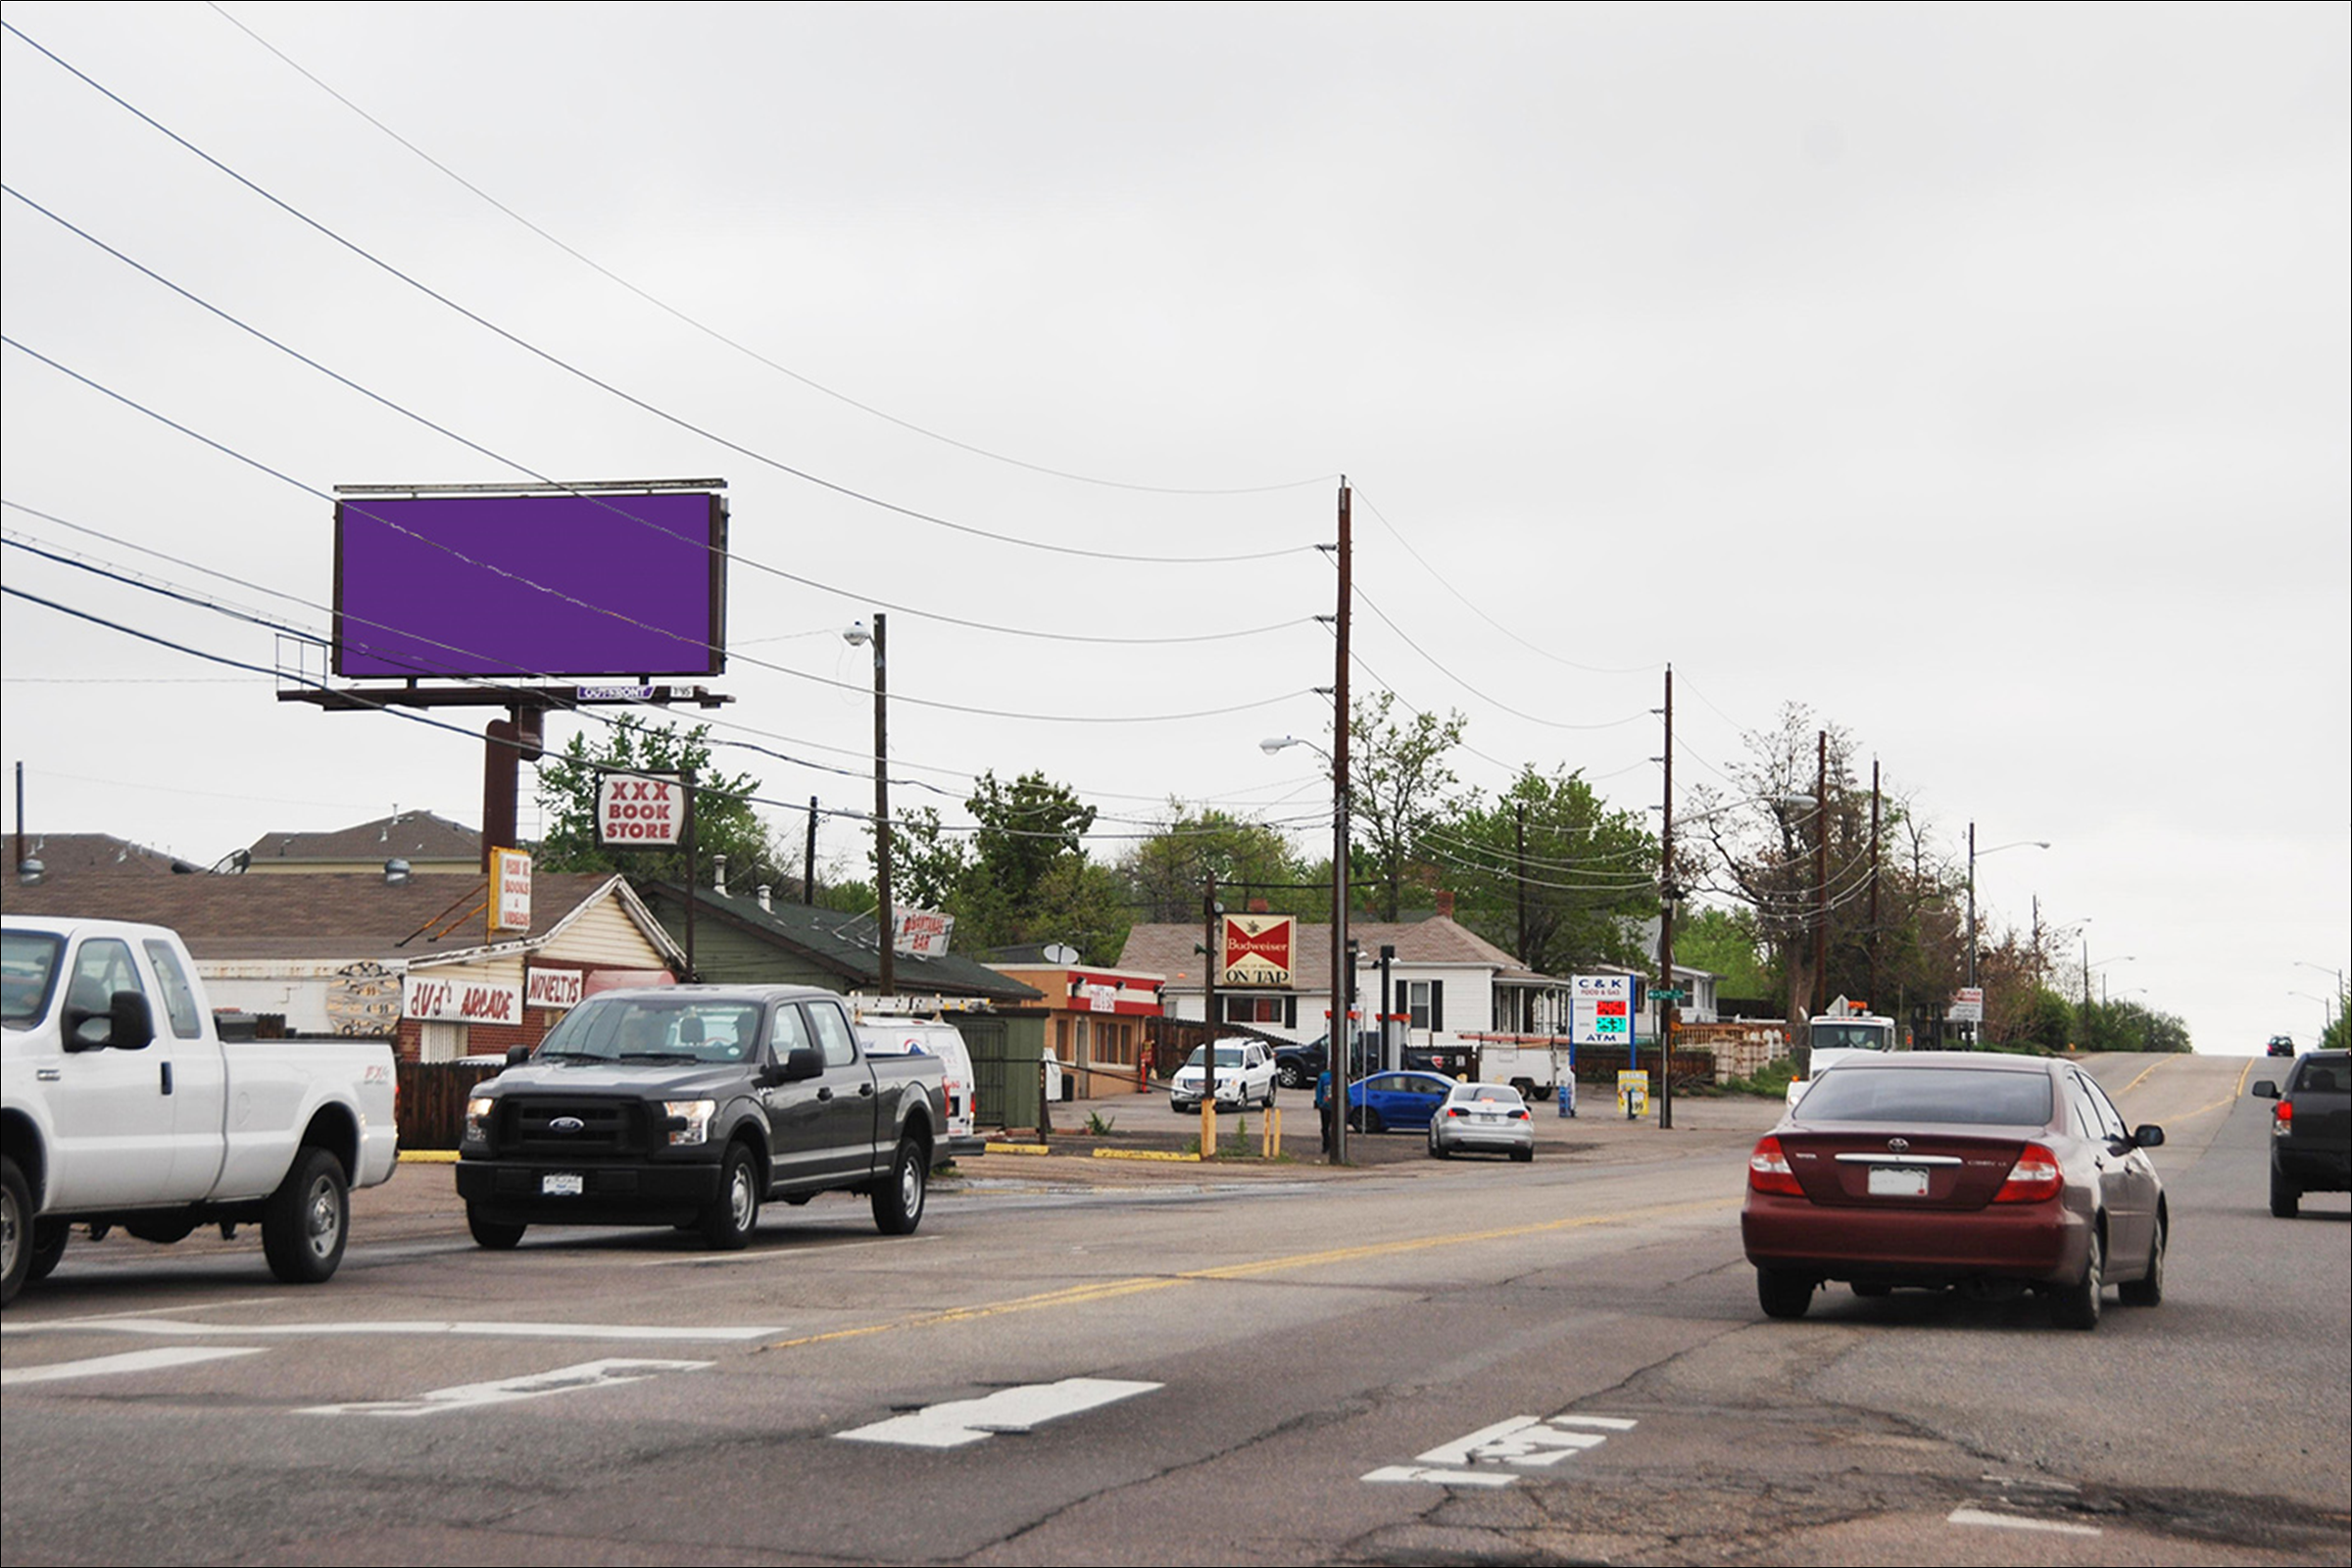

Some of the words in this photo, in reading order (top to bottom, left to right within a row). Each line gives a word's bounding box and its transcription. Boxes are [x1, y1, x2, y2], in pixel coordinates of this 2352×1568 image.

[610, 781, 671, 801] XXX
[608, 804, 671, 820] BOOK
[606, 821, 671, 839] STORE
[505, 879, 530, 896] BOOKS
[504, 910, 530, 927] VIDEOS
[912, 933, 932, 952] BAR
[1228, 937, 1290, 953] Budweiser
[1225, 969, 1250, 984] ON
[1252, 969, 1290, 984] TAP
[1579, 979, 1589, 988] C
[1594, 979, 1605, 988] &
[1611, 979, 1622, 988] K
[460, 987, 514, 1021] ARCADE
